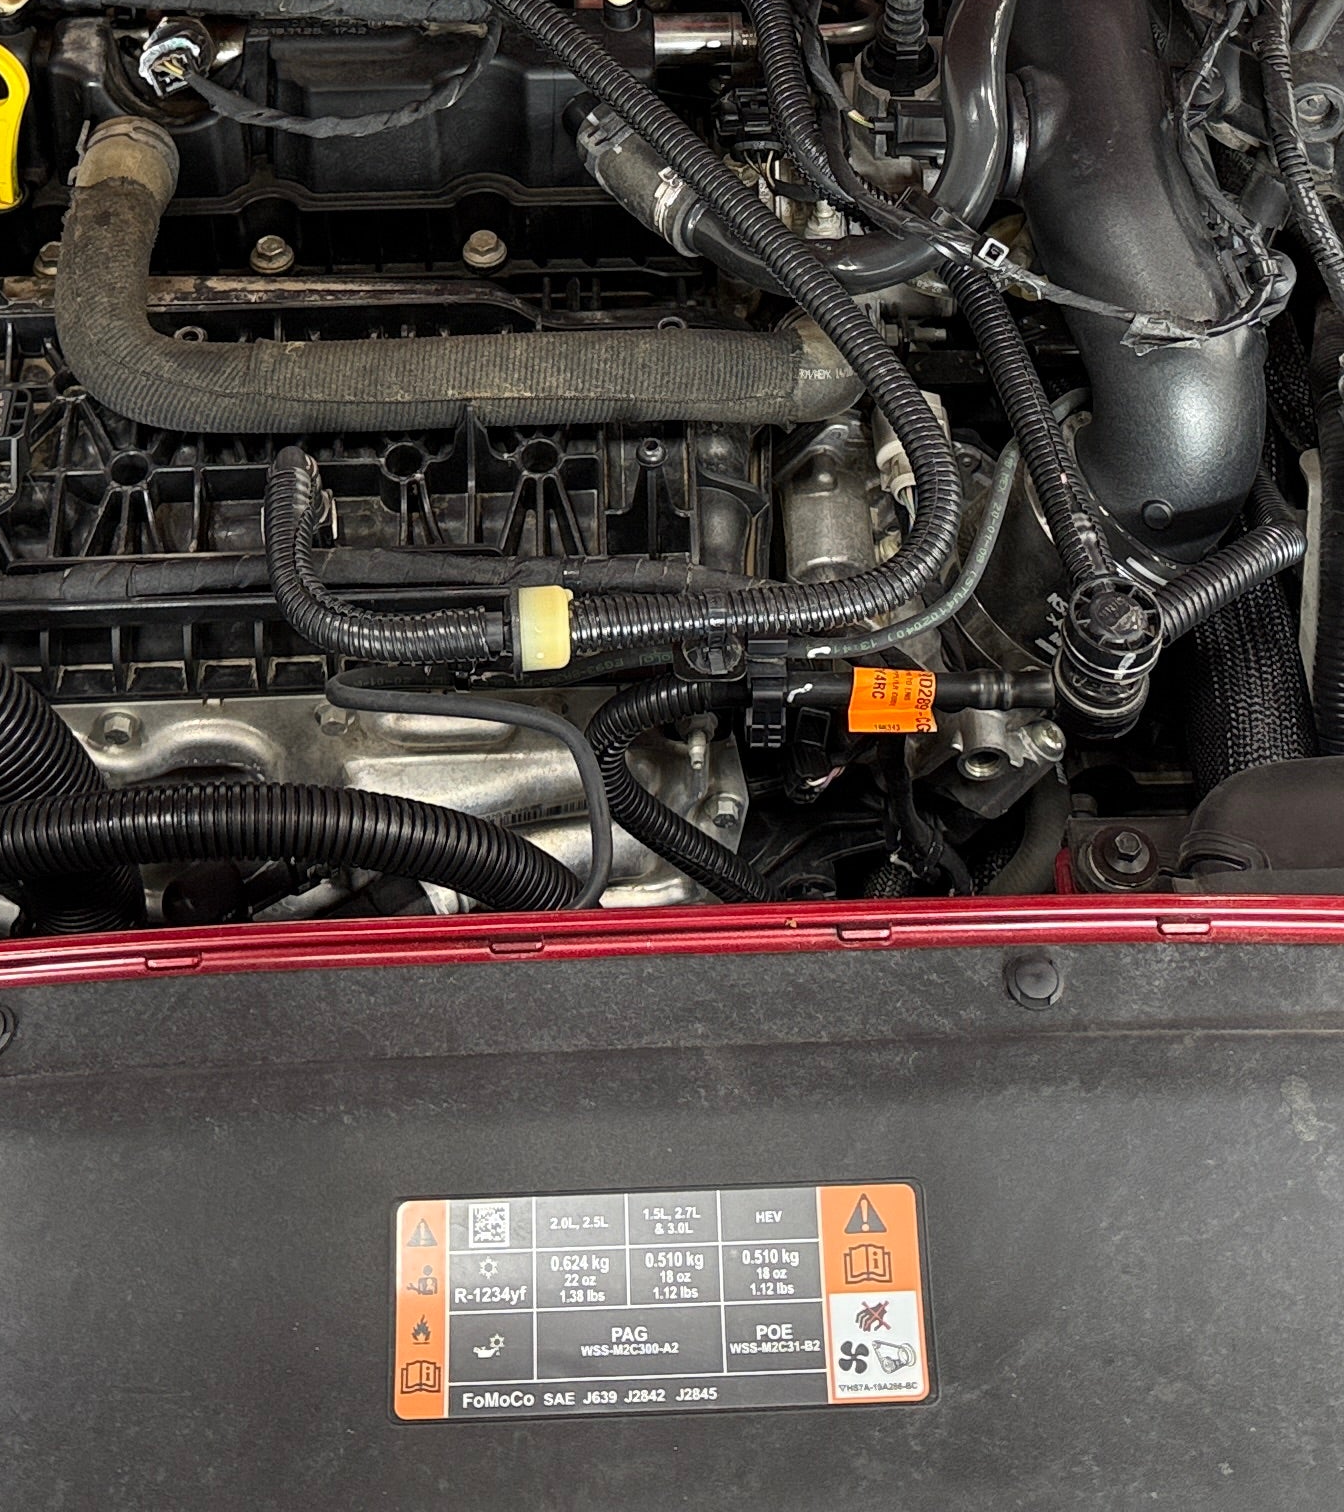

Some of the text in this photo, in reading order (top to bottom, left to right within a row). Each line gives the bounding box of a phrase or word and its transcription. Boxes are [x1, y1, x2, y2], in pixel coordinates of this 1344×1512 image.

[643, 1207, 701, 1220] 1.5L, 2.7L
[756, 1210, 782, 1223] HEV
[550, 1216, 609, 1230] 2.0L, 2.5L
[655, 1222, 694, 1234] & 3.0L
[550, 1254, 609, 1273] 0.624 kg
[645, 1251, 704, 1270] 0.510 kg
[742, 1248, 799, 1266] 0.510 kg
[564, 1274, 597, 1286] 22 oz
[659, 1270, 691, 1283] 18 oz
[757, 1267, 787, 1280] 18 oz
[454, 1286, 528, 1305] R-1234yf
[560, 1290, 605, 1303] 1.38 lbs
[652, 1285, 698, 1300] 1.12 lbs
[750, 1282, 795, 1296] 1.12 lbs
[611, 1326, 648, 1342] PAG
[756, 1324, 794, 1340] POE
[581, 1342, 679, 1357] WSS-M2C300-A2
[730, 1339, 820, 1355] WSS-M2C31-B2
[462, 1388, 717, 1408] FoMoCo SAE J639 J2842 J2845
